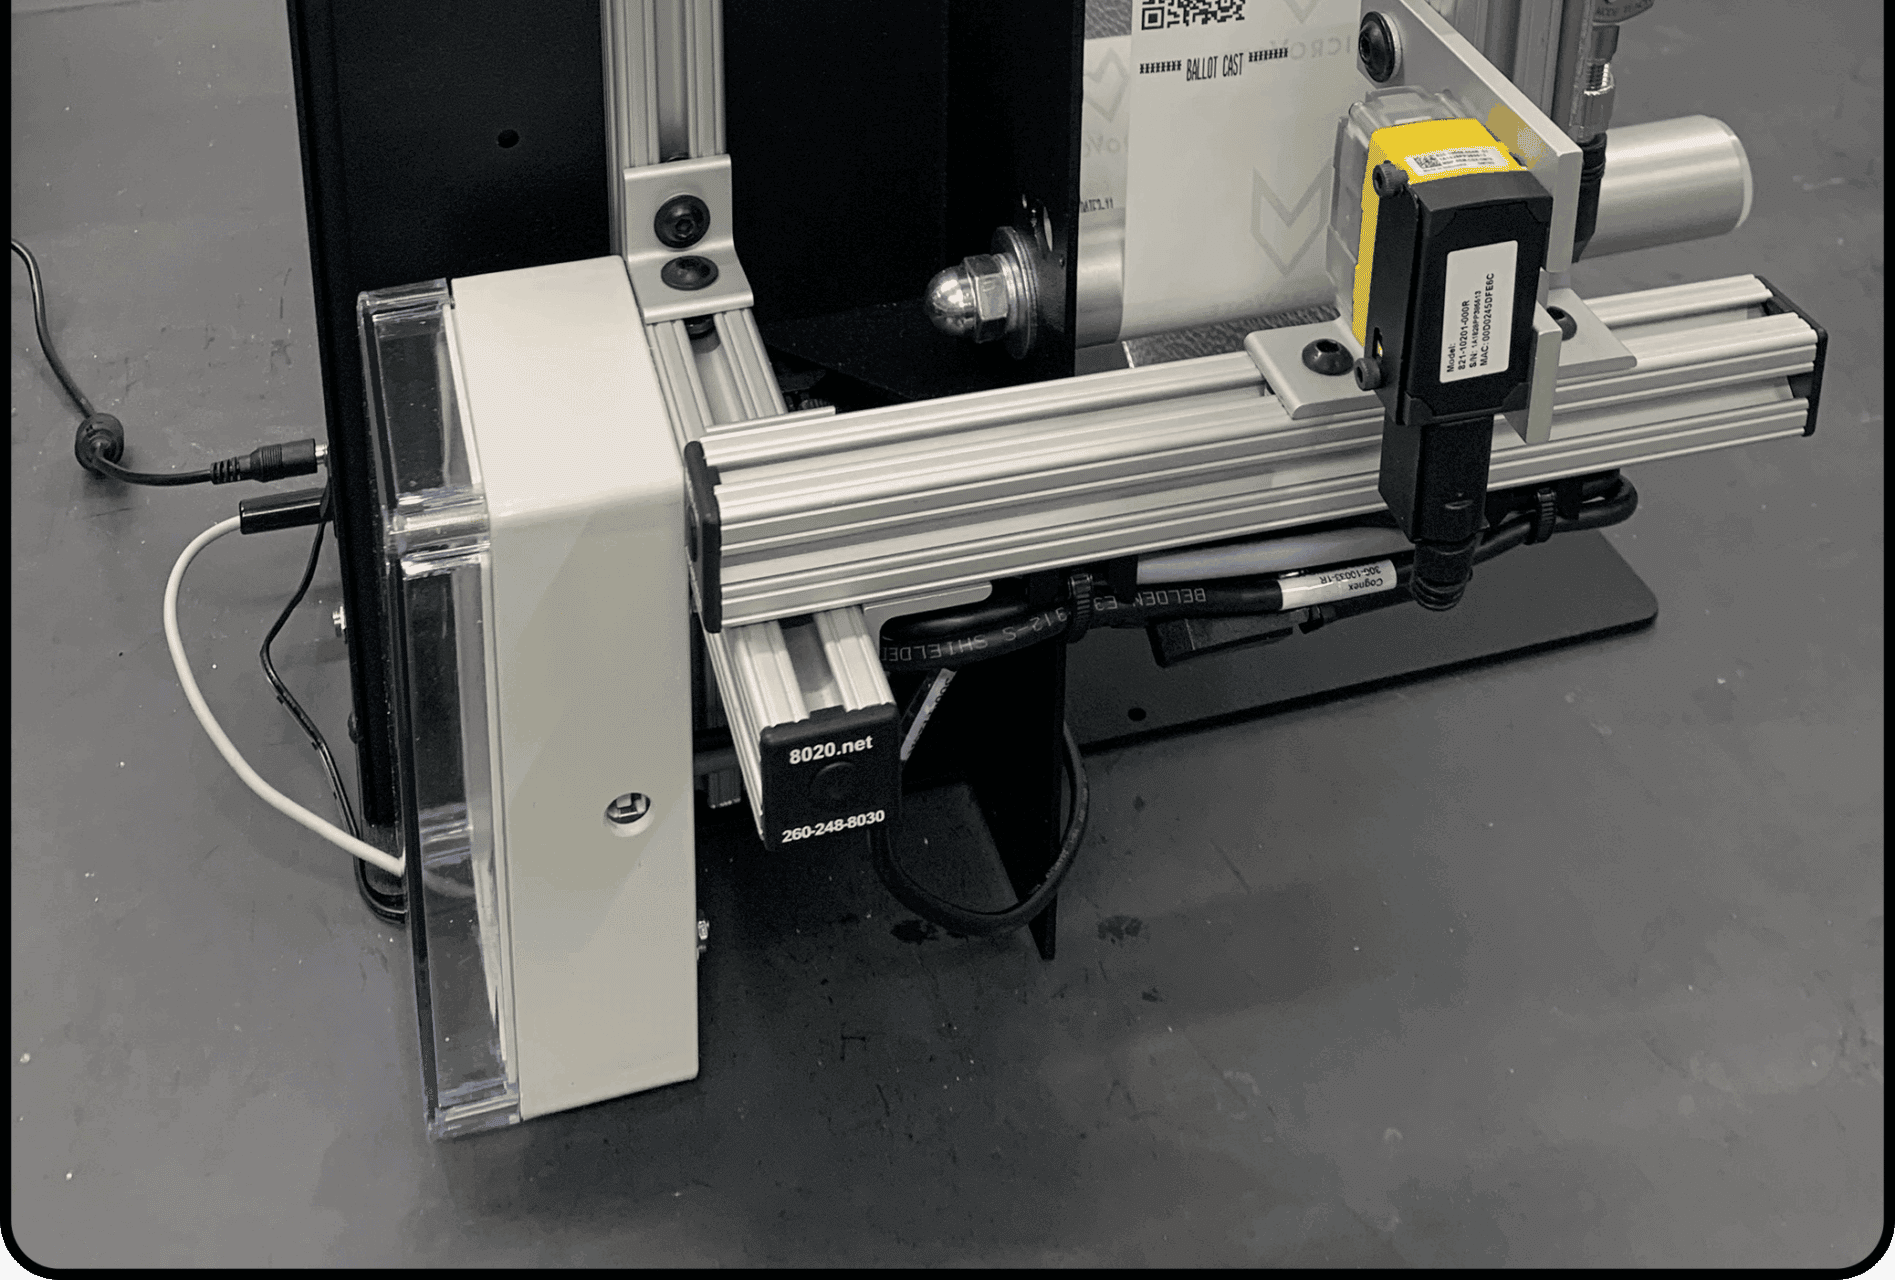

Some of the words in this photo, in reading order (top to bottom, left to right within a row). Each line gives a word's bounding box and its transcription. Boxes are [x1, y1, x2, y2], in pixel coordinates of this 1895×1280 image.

[1186, 55, 1218, 81] BALLOT
[1222, 52, 1244, 77] CAST
[1457, 299, 1471, 370] 821-10201-000R
[1446, 342, 1456, 373] Model:
[1132, 587, 1207, 607] BELDEN
[1347, 577, 1384, 592] Cognex
[789, 734, 874, 765] 8020.net
[782, 809, 886, 844] 260-248-8030
